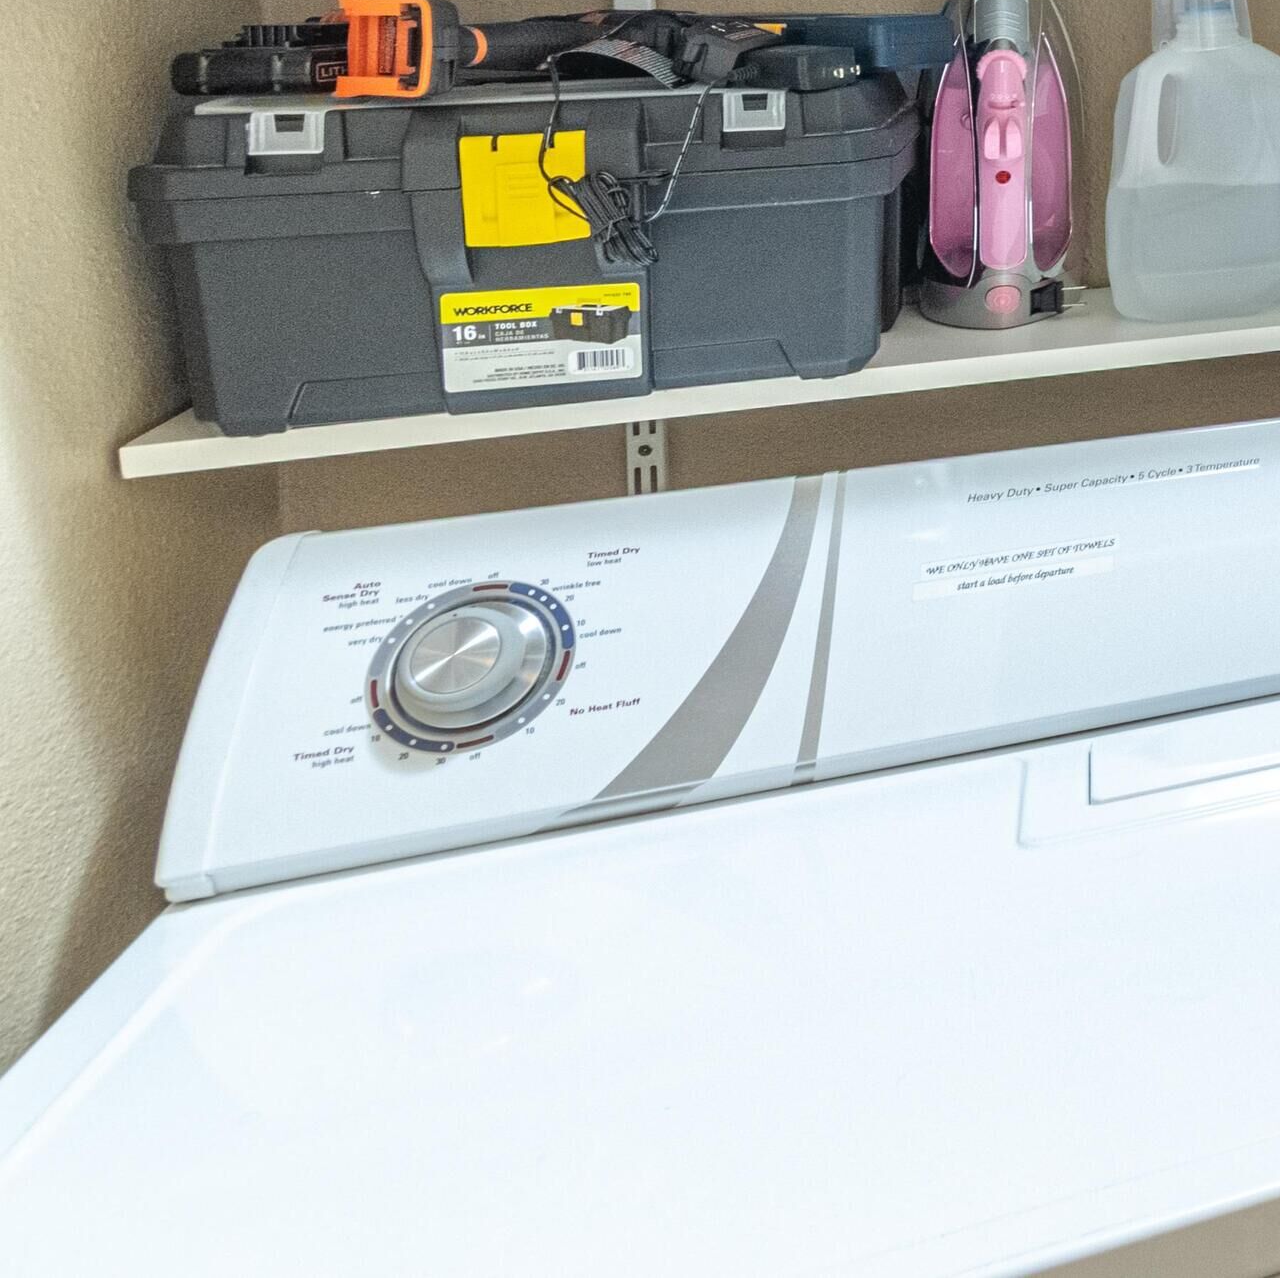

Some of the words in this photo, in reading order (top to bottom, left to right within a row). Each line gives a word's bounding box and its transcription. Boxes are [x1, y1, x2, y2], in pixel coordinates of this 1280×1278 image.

[453, 303, 533, 317] WORKFORCE
[495, 322, 517, 330] TOOL
[520, 320, 537, 328] BOX
[452, 325, 477, 341] 16
[967, 492, 1004, 503] Heavy
[1006, 487, 1034, 499] Duty
[1044, 481, 1078, 494] Super
[1080, 473, 1129, 489] Capacity
[1138, 471, 1145, 480] 5
[1147, 467, 1177, 480] Cycle
[1186, 464, 1193, 474] 3
[1195, 457, 1260, 473] Temperature
[588, 547, 619, 559] Timed
[622, 546, 640, 555] Dry
[926, 565, 946, 575] WE
[947, 558, 979, 573] ONLY
[1012, 551, 1036, 562] ONE
[1057, 545, 1073, 555] OF
[1072, 538, 1115, 553] TOWELS
[587, 559, 602, 567] low
[604, 557, 622, 565] heat
[354, 580, 381, 590] Auto
[428, 579, 447, 589] cool
[448, 577, 473, 586] down
[957, 580, 978, 591] start
[987, 575, 1006, 586] load
[1007, 572, 1034, 585] before
[1035, 566, 1075, 579] departure
[552, 582, 583, 592] wrinkle
[584, 579, 601, 588] free
[322, 592, 356, 603] Sense
[360, 588, 380, 598] Dry
[396, 596, 413, 604] less
[414, 593, 430, 602] dry
[339, 601, 358, 610] high
[360, 598, 379, 606] heat
[323, 621, 353, 633] energy
[355, 616, 396, 629] preferred
[579, 630, 597, 639] cool
[599, 627, 622, 636] down
[348, 637, 367, 647] very
[369, 635, 385, 644] dry
[569, 707, 585, 716] No
[588, 703, 613, 713] Heat
[616, 698, 641, 709] Fluff
[323, 727, 345, 737] cool
[348, 724, 372, 733] down
[294, 748, 331, 762] Timed
[333, 745, 355, 756] Dry
[312, 759, 332, 769] high
[334, 755, 355, 765] heat
